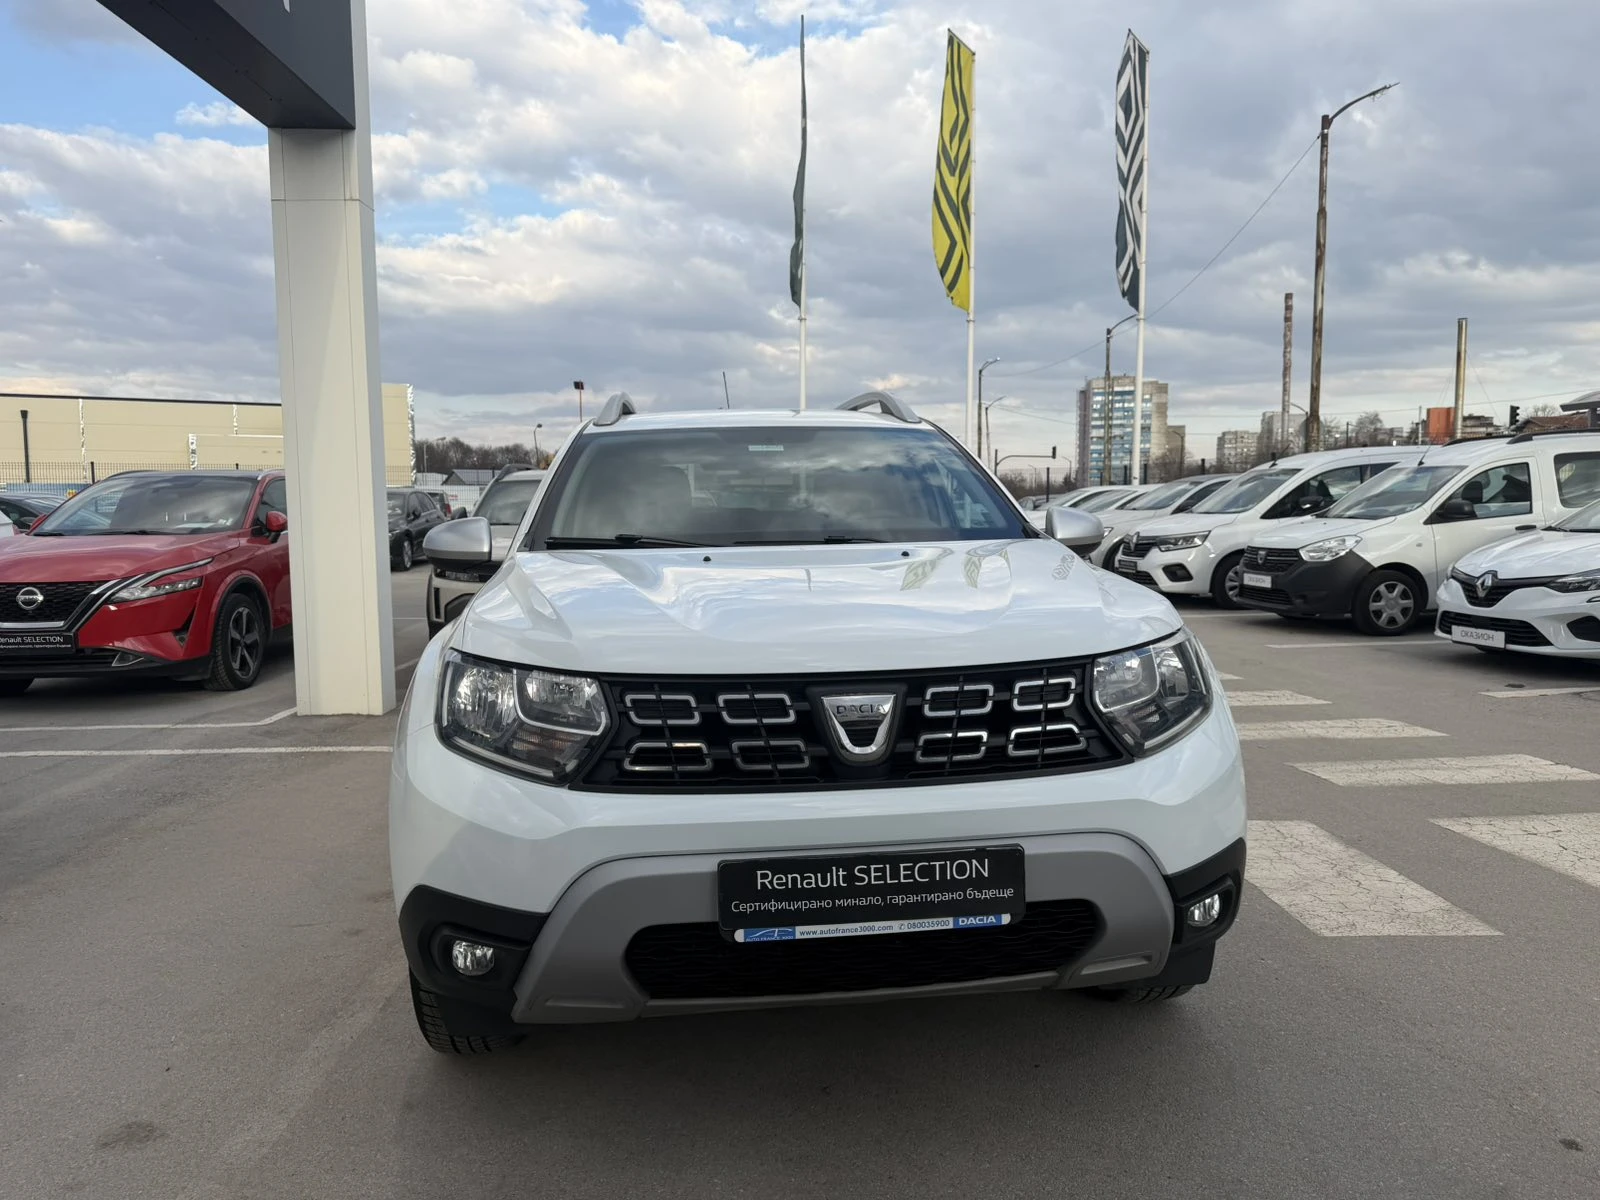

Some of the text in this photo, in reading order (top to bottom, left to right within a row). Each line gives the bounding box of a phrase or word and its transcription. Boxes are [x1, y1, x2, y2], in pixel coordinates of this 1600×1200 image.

[836, 704, 886, 715] DACIA
[756, 858, 989, 890] Renault SELECTION
[731, 887, 1014, 914] Сертифицирано минало, гарантирано бъдеще
[799, 924, 894, 936] www.autofrance3000.com
[959, 915, 996, 926] DACIA
